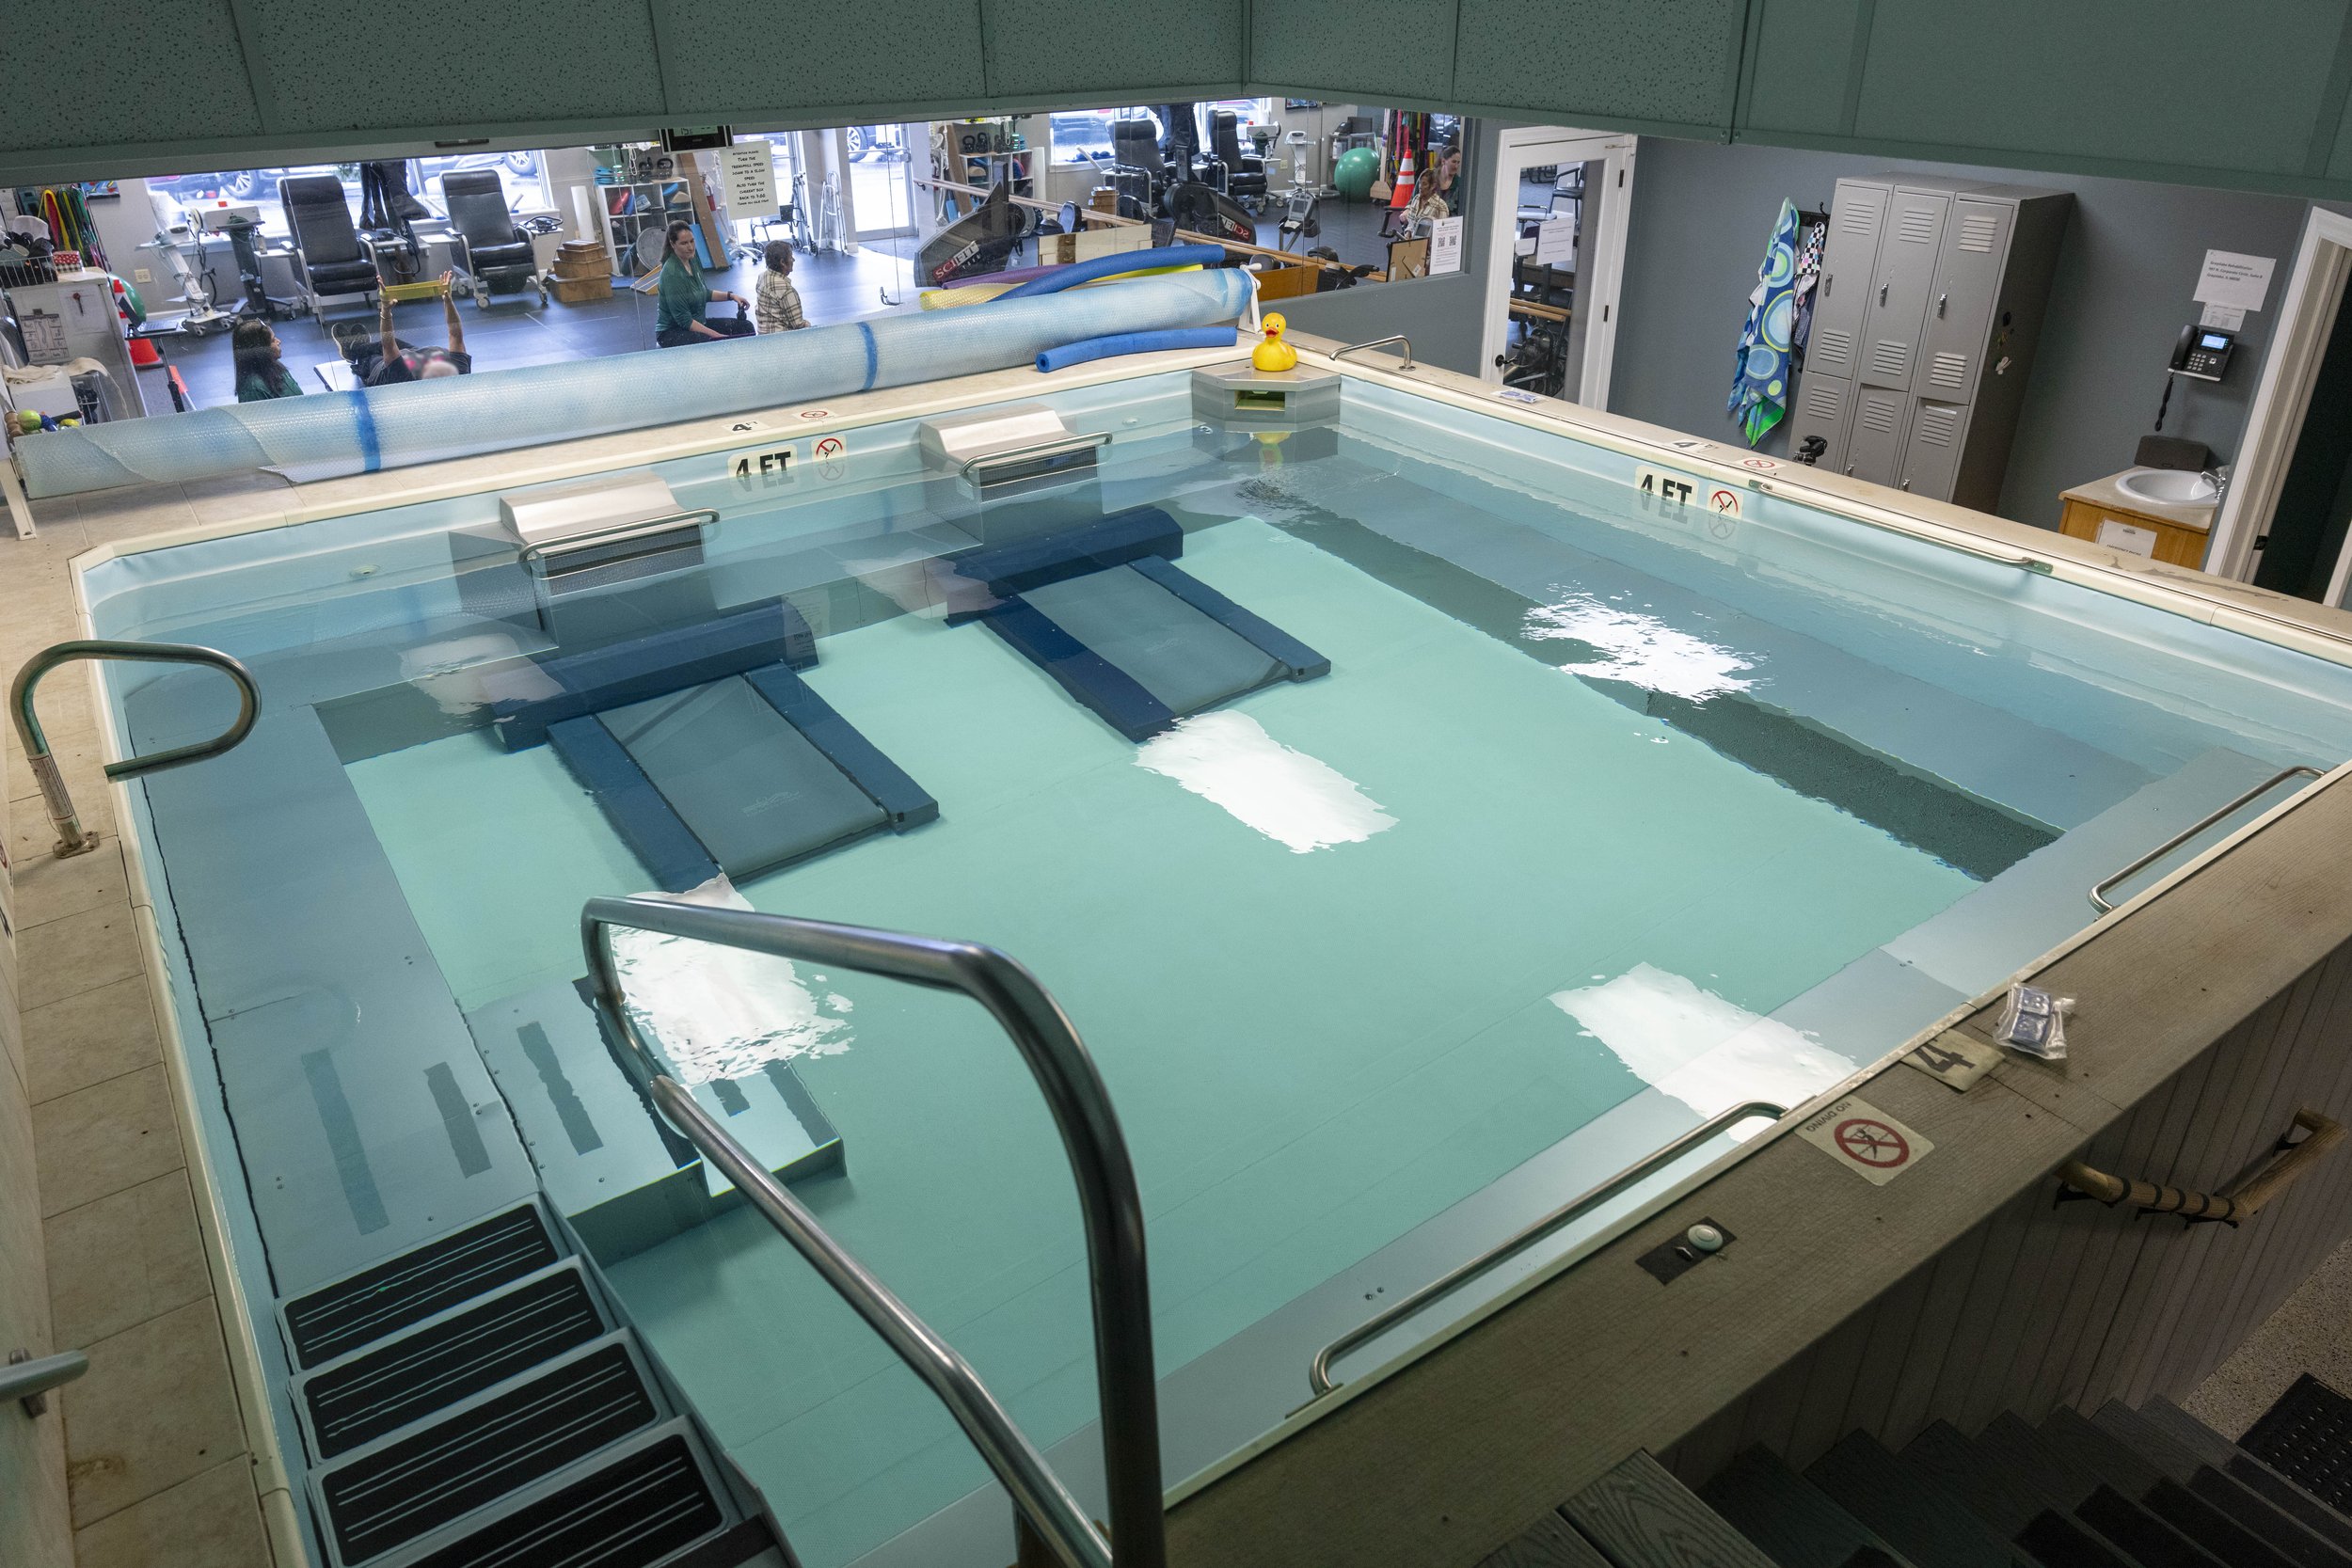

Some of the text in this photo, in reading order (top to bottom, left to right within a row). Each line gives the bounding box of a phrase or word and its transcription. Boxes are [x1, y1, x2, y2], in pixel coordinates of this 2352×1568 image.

[736, 458, 752, 479] 4
[1641, 474, 1654, 494] 4
[1805, 1101, 1852, 1133] NO DIVING
